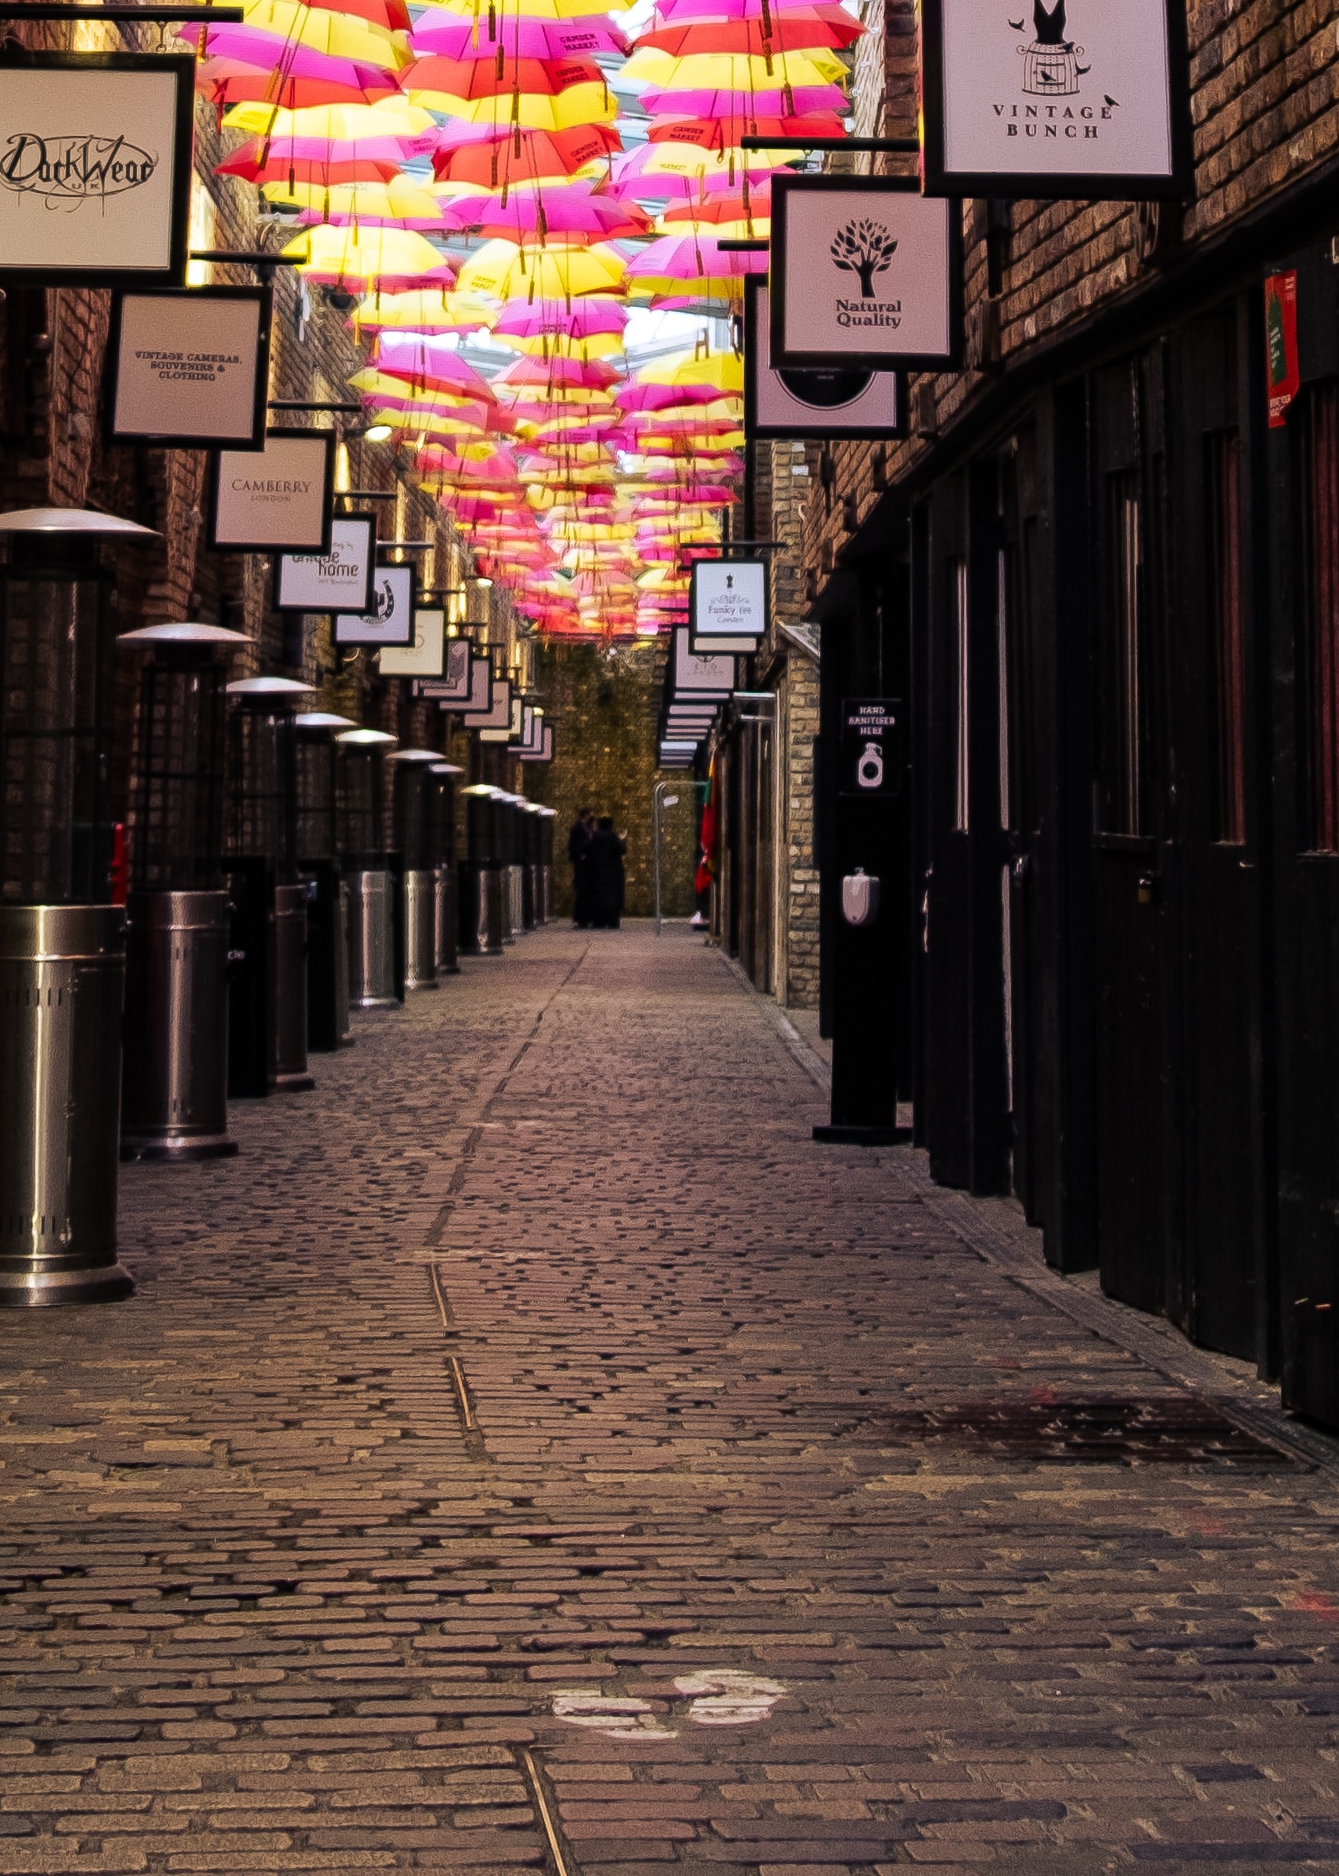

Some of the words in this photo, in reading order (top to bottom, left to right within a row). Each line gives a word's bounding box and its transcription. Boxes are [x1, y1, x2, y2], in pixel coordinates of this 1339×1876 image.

[993, 104, 1112, 119] VINTAGE
[1007, 124, 1098, 138] BUNCH
[836, 299, 901, 312] Natural
[837, 312, 901, 329] Quality
[135, 351, 183, 361] VINTAGE
[151, 361, 214, 372] SOUVENIRS
[217, 364, 225, 372] &
[159, 371, 216, 381] CLOTHING
[232, 479, 311, 493] CAMBERRY
[860, 706, 885, 714] HAND
